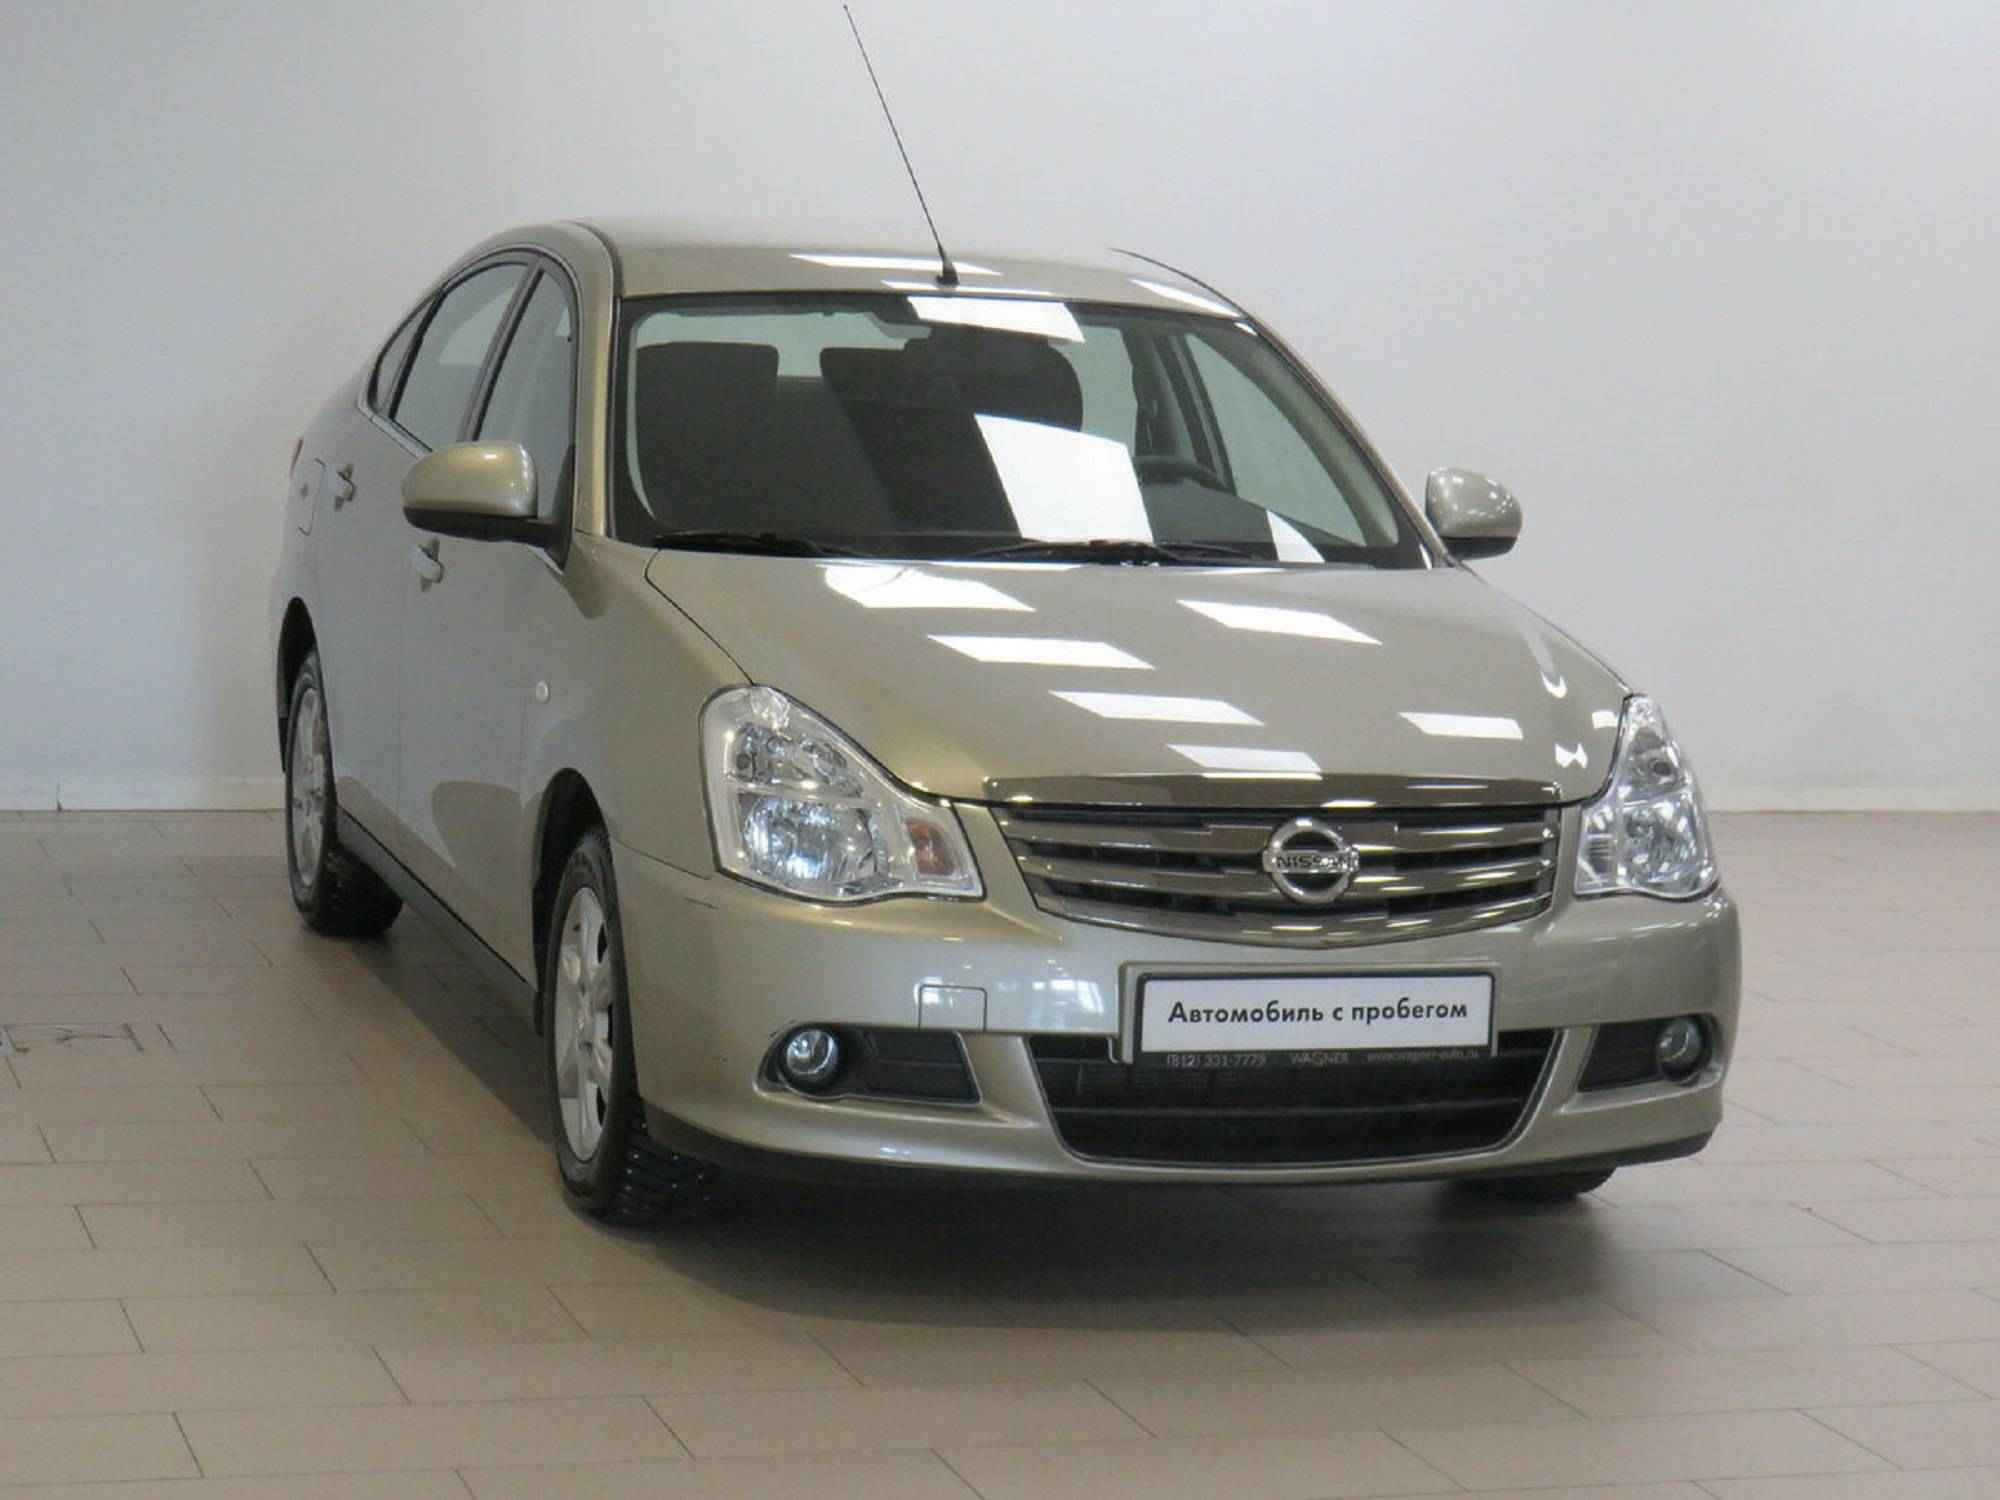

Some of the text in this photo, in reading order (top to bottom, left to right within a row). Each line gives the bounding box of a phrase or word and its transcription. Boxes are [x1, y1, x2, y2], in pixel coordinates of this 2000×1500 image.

[1277, 854, 1358, 870] NISSAN
[1168, 998, 1468, 1025] Автомобиль с пробегом
